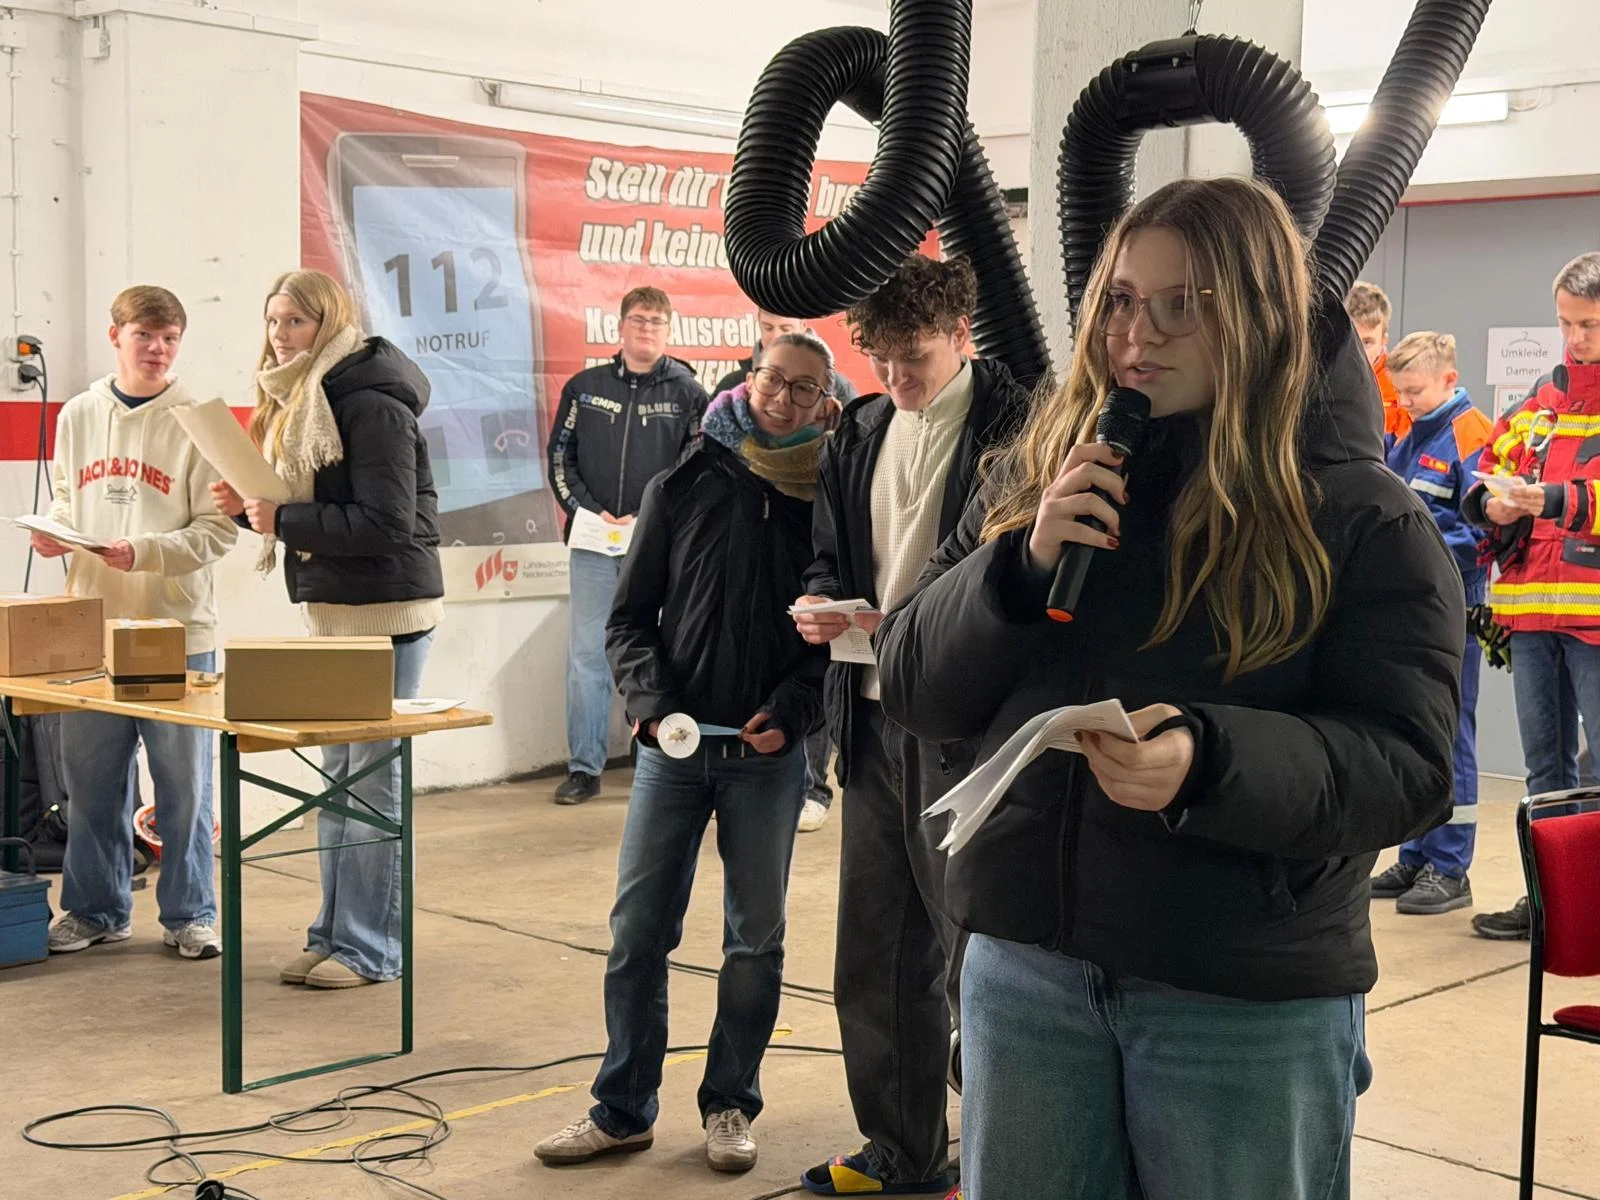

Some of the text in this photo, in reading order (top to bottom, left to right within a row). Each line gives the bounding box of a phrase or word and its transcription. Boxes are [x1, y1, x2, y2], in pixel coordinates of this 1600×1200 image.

[585, 156, 668, 204] Stell
[668, 166, 720, 208] dir
[579, 219, 647, 266] und
[383, 246, 509, 318] 112
[416, 330, 492, 354] NOTRUF
[668, 310, 760, 348] Ausred
[1501, 348, 1548, 359] Umkleide
[1505, 366, 1541, 377] Damen
